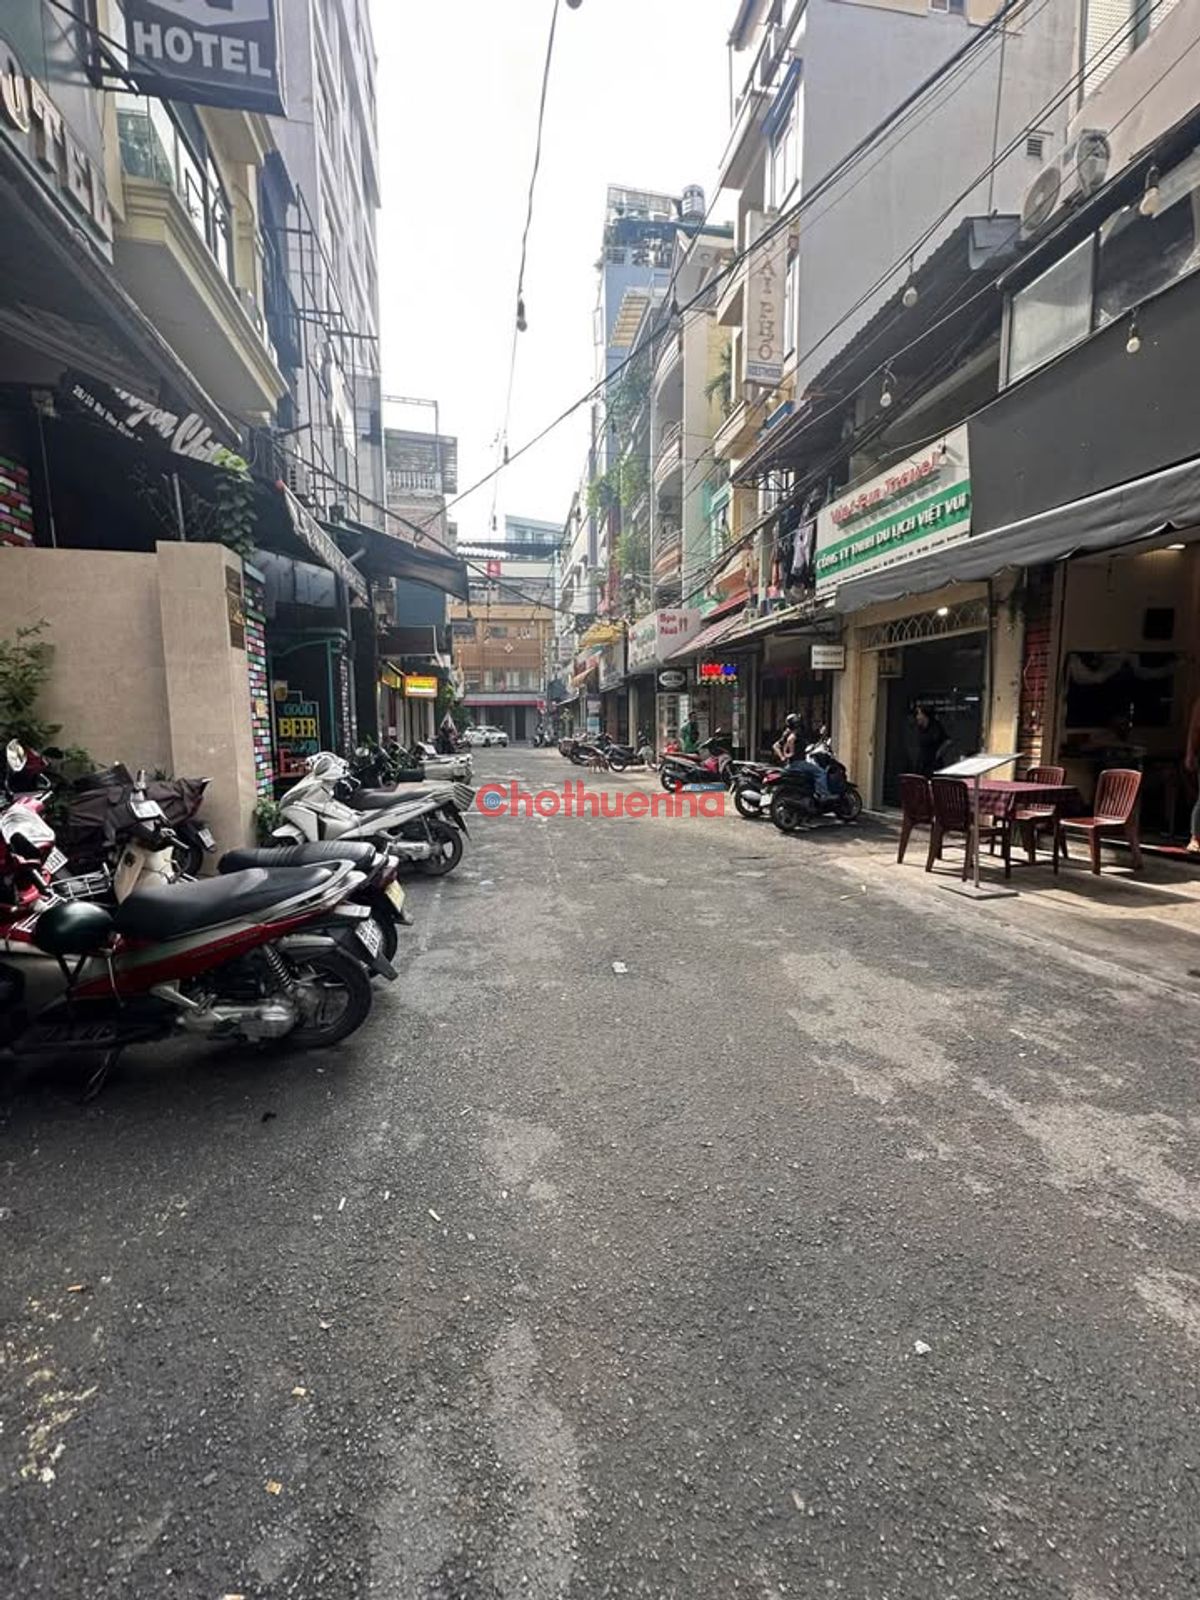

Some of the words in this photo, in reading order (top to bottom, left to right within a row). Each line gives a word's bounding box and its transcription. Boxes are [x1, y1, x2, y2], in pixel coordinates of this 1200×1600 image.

[133, 21, 271, 78] HOTEL
[876, 529, 891, 546] DU
[891, 517, 916, 540] LỊCH
[916, 503, 943, 526] VIỆT
[278, 717, 317, 738] BEER
